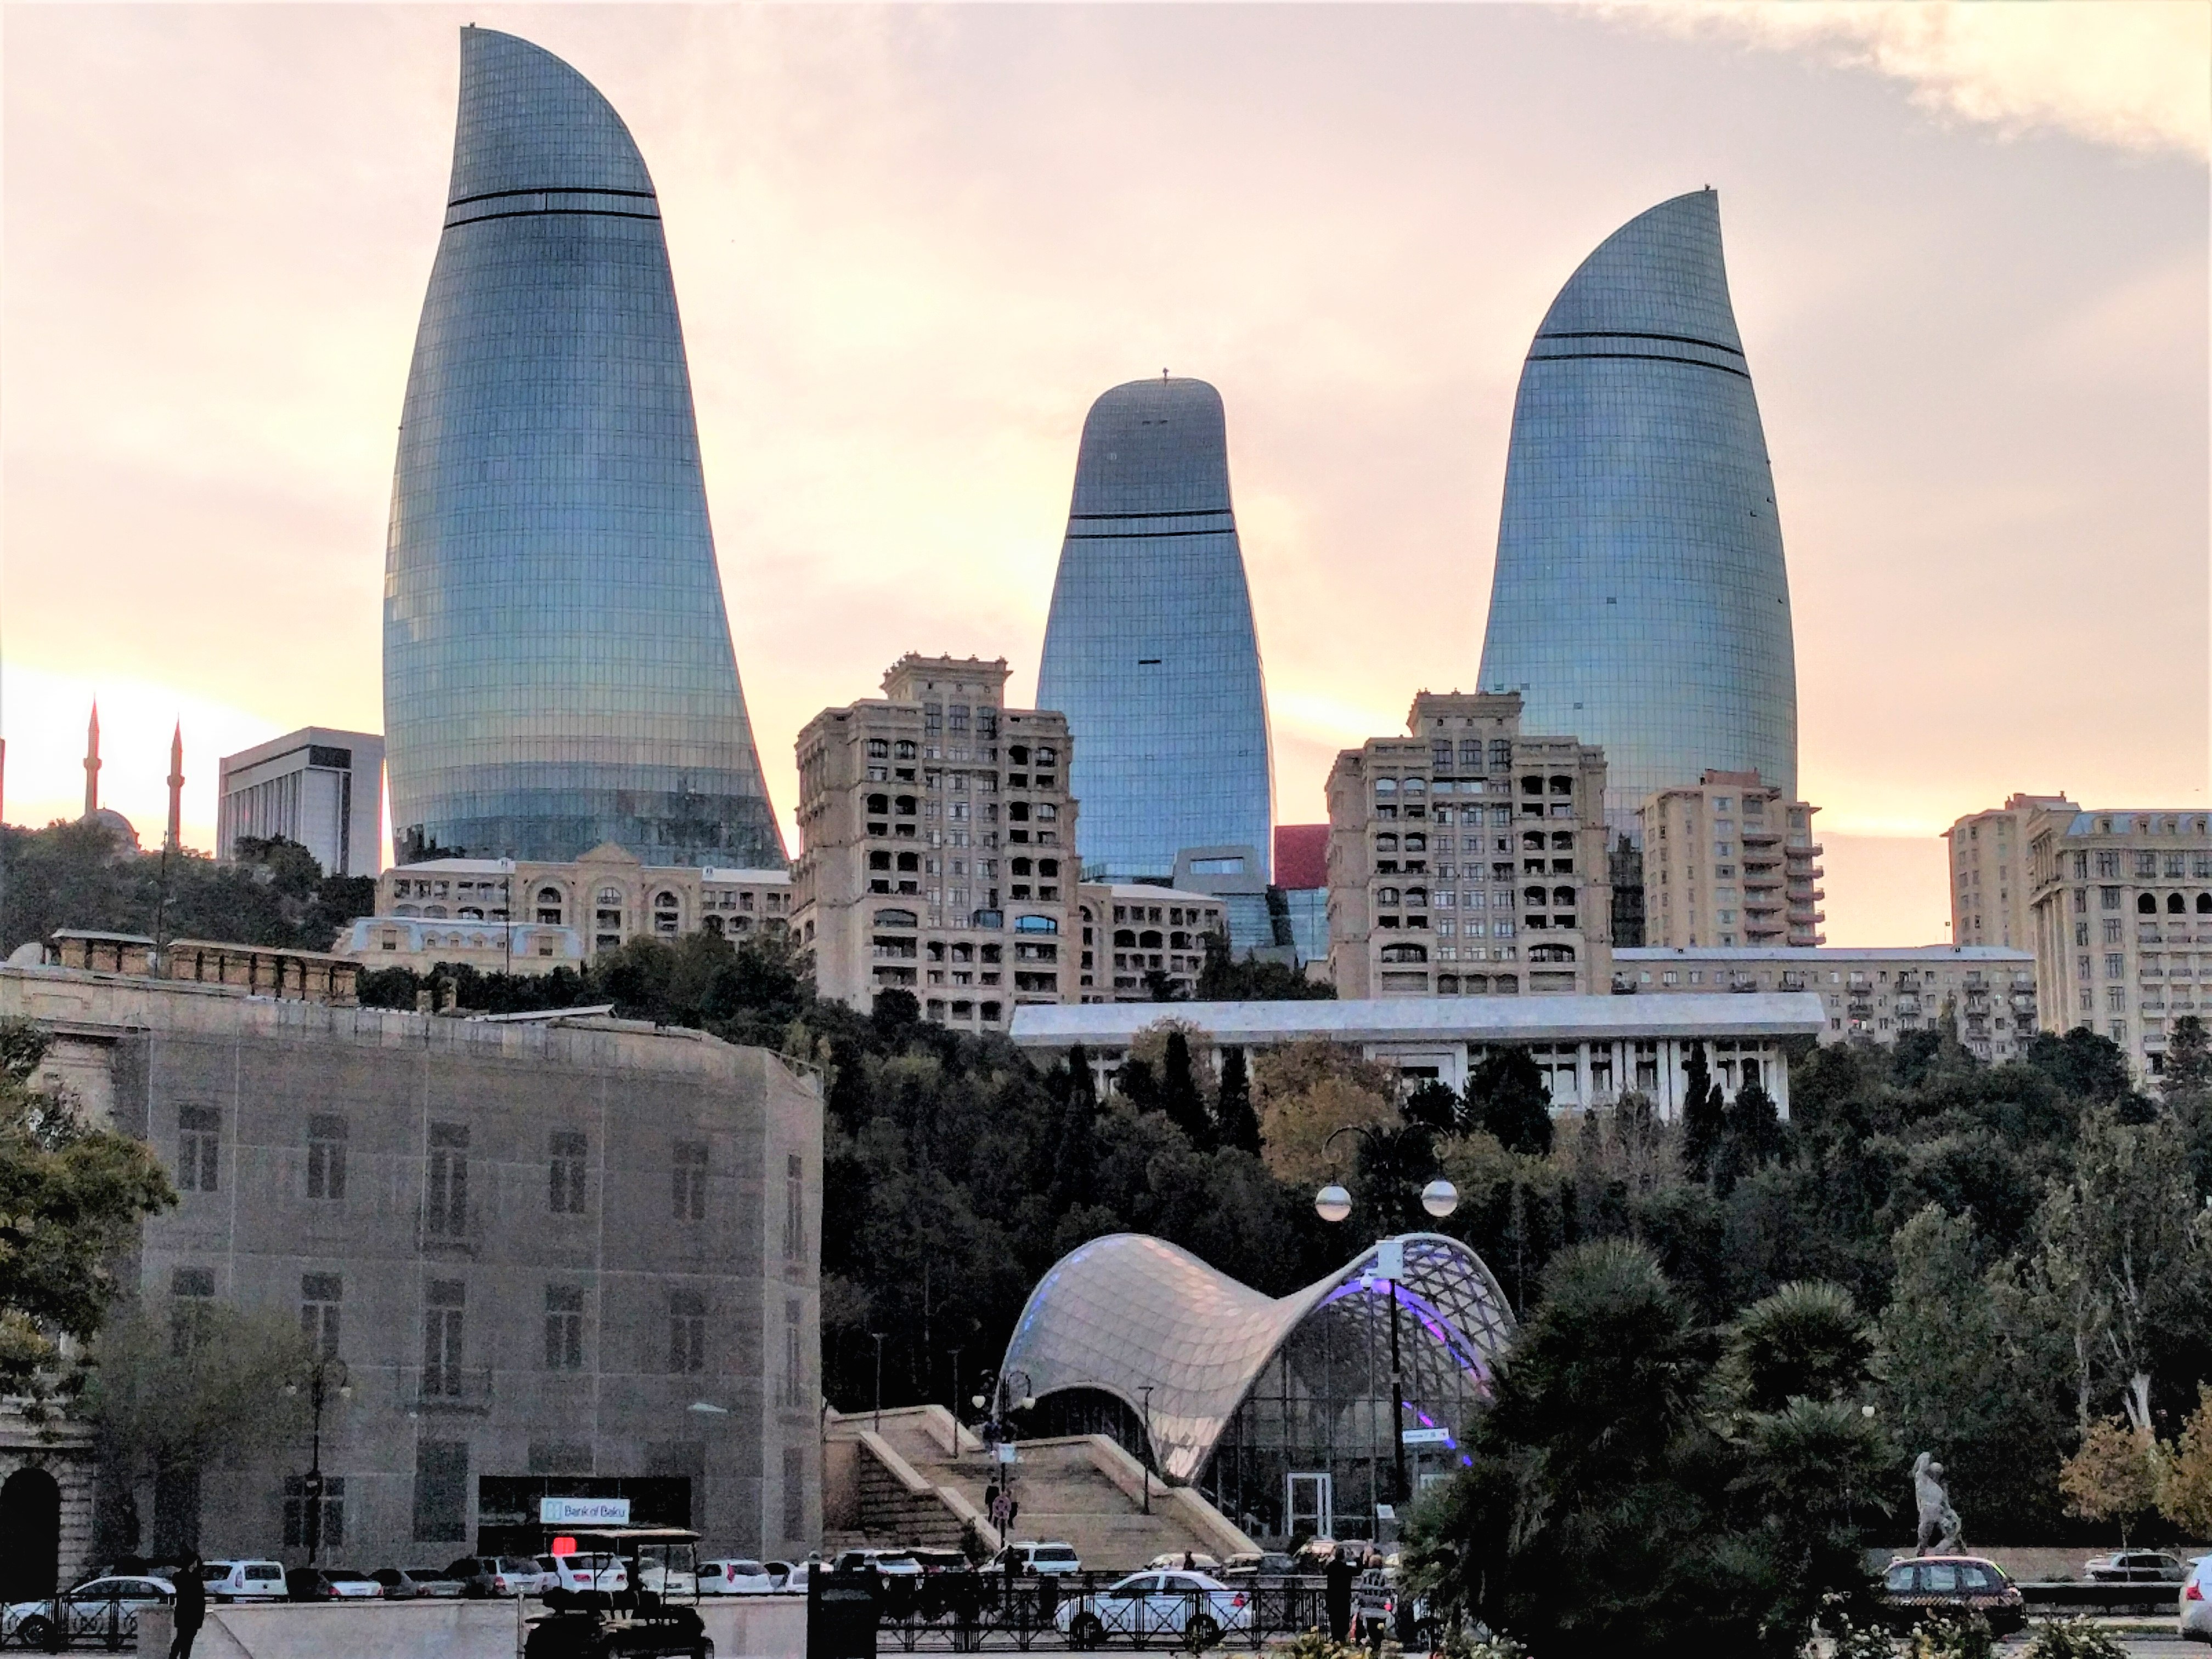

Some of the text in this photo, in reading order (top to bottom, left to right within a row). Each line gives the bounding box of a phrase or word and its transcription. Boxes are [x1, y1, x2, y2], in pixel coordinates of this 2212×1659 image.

[565, 1505, 625, 1517] Bank of Baku
